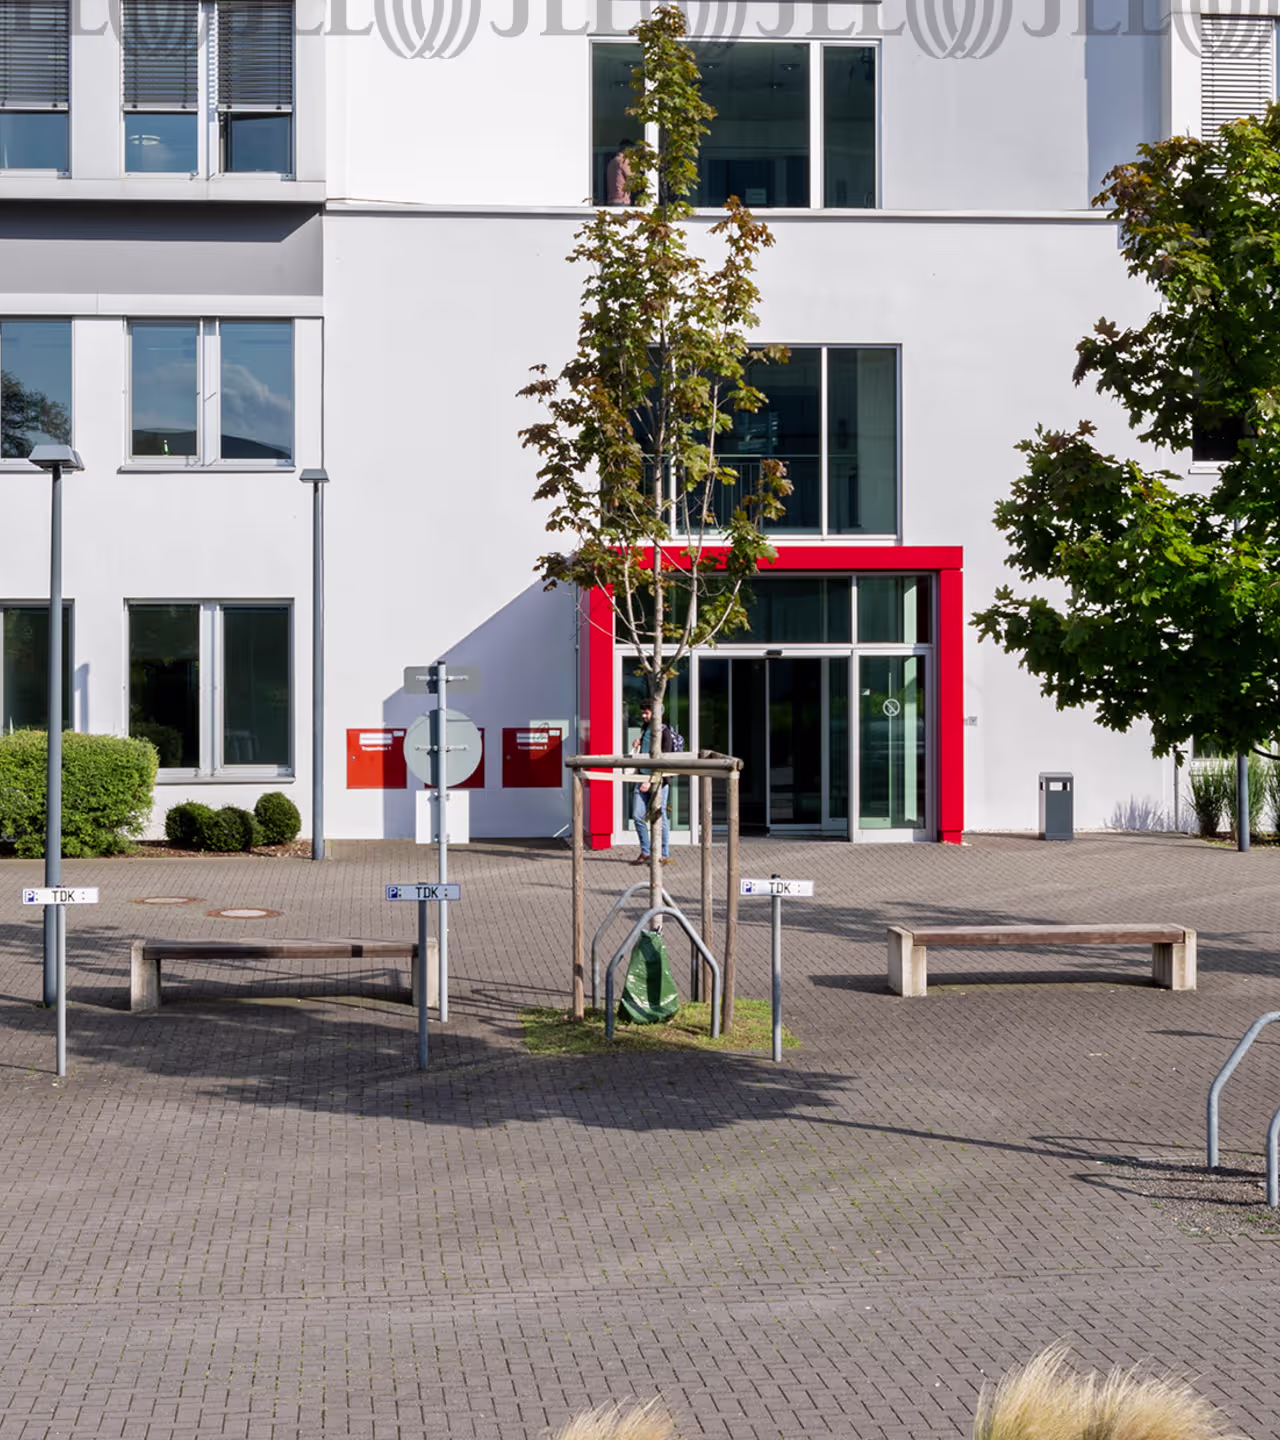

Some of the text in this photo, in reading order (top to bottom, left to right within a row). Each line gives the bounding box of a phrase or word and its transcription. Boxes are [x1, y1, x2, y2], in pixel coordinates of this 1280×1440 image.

[415, 886, 439, 898] TDK
[768, 882, 792, 894] TDK
[51, 890, 76, 902] TDK
